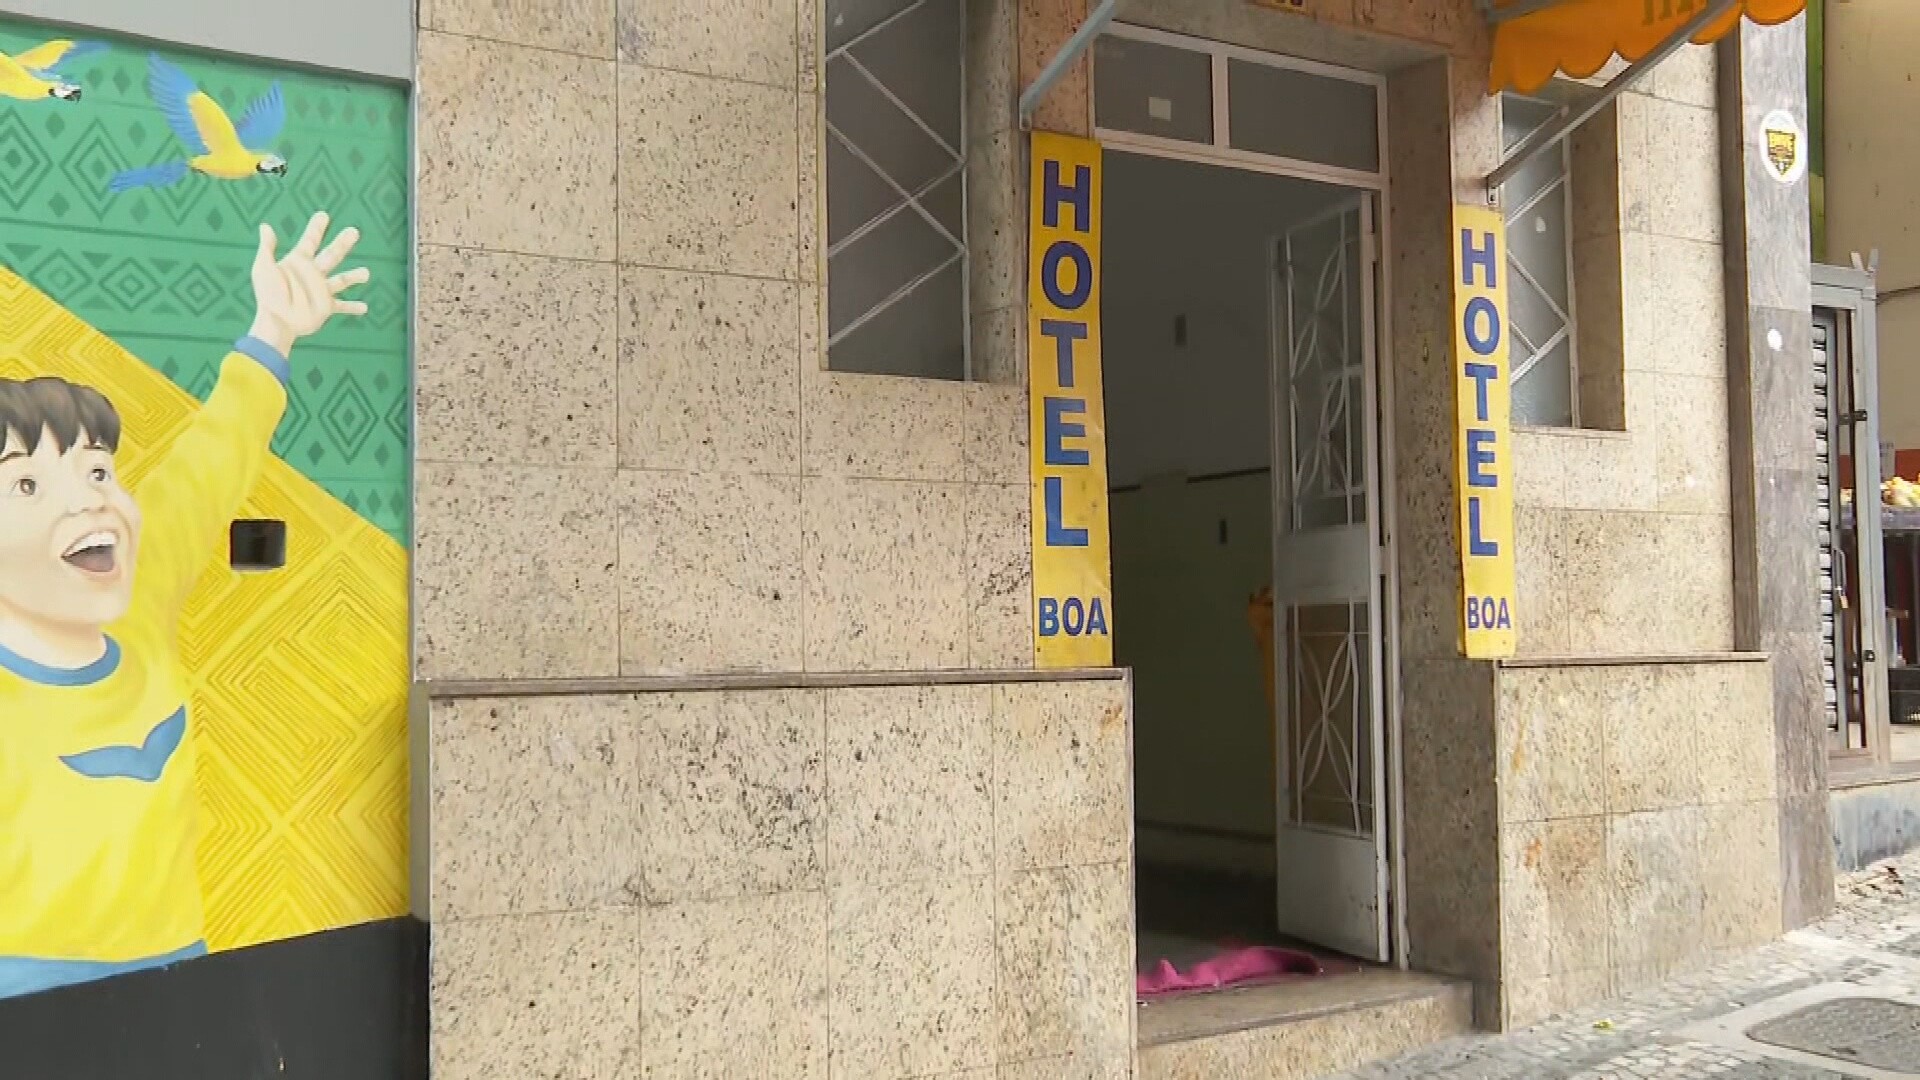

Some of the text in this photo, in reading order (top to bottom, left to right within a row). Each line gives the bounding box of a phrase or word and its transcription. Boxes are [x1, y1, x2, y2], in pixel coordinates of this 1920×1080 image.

[1041, 160, 1092, 547] HOTEL
[1461, 229, 1501, 557] HOTEL
[1038, 597, 1108, 636] BOA
[1467, 597, 1511, 630] BOA
